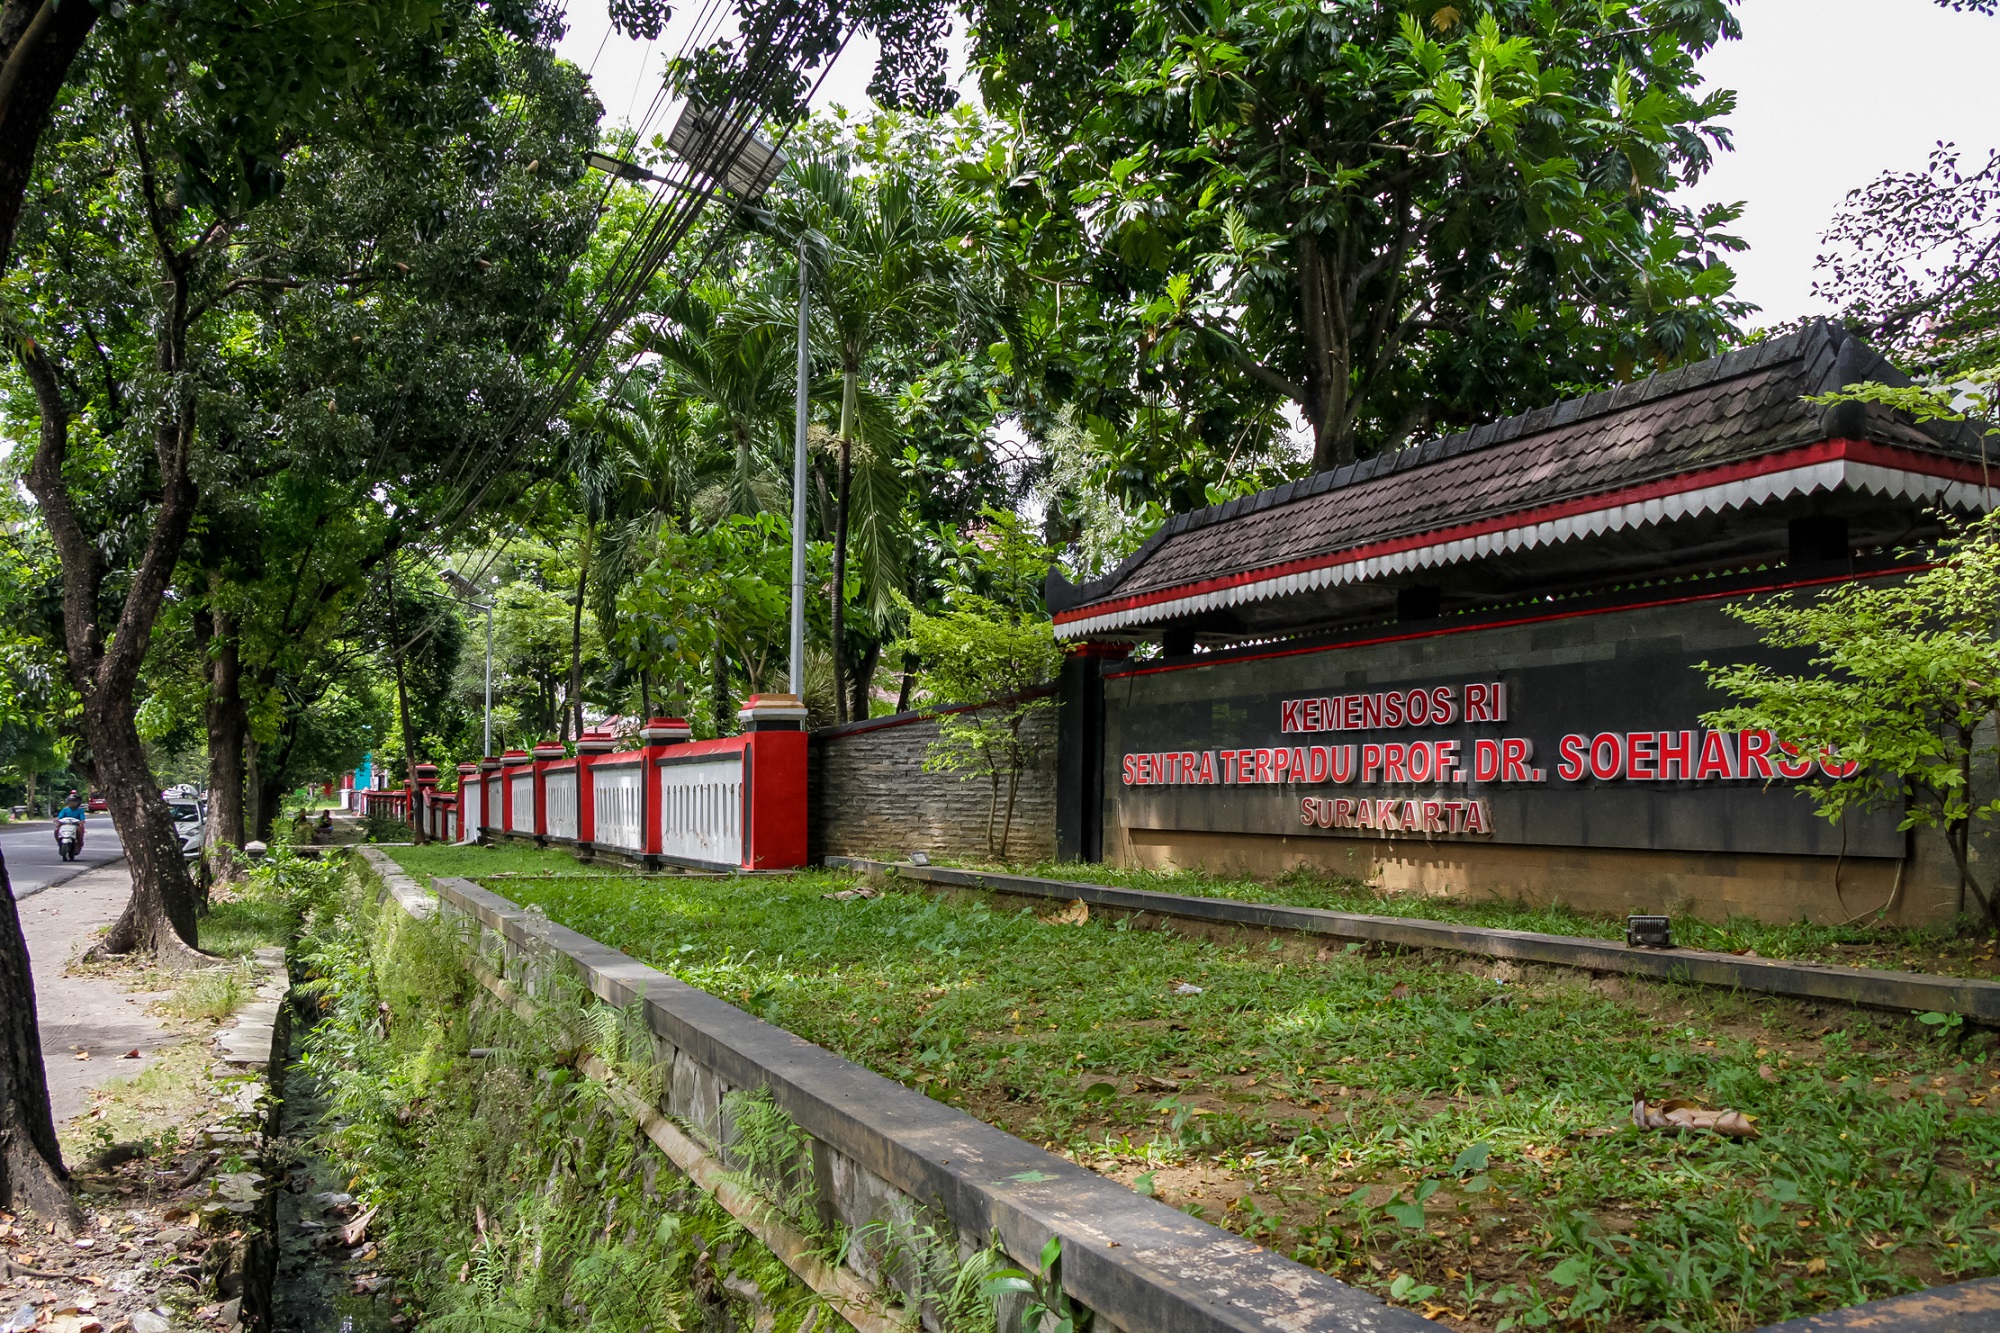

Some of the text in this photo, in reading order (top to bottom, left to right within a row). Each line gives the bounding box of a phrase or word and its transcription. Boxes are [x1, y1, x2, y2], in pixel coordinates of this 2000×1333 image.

[1280, 682, 1505, 733] KEMENSOS RI
[1122, 751, 1217, 785] SENTRA
[1220, 744, 1355, 785] TERPADU
[1361, 740, 1464, 783] PROF.
[1474, 738, 1545, 782] DR.
[1300, 797, 1486, 833] SURAKARTA
